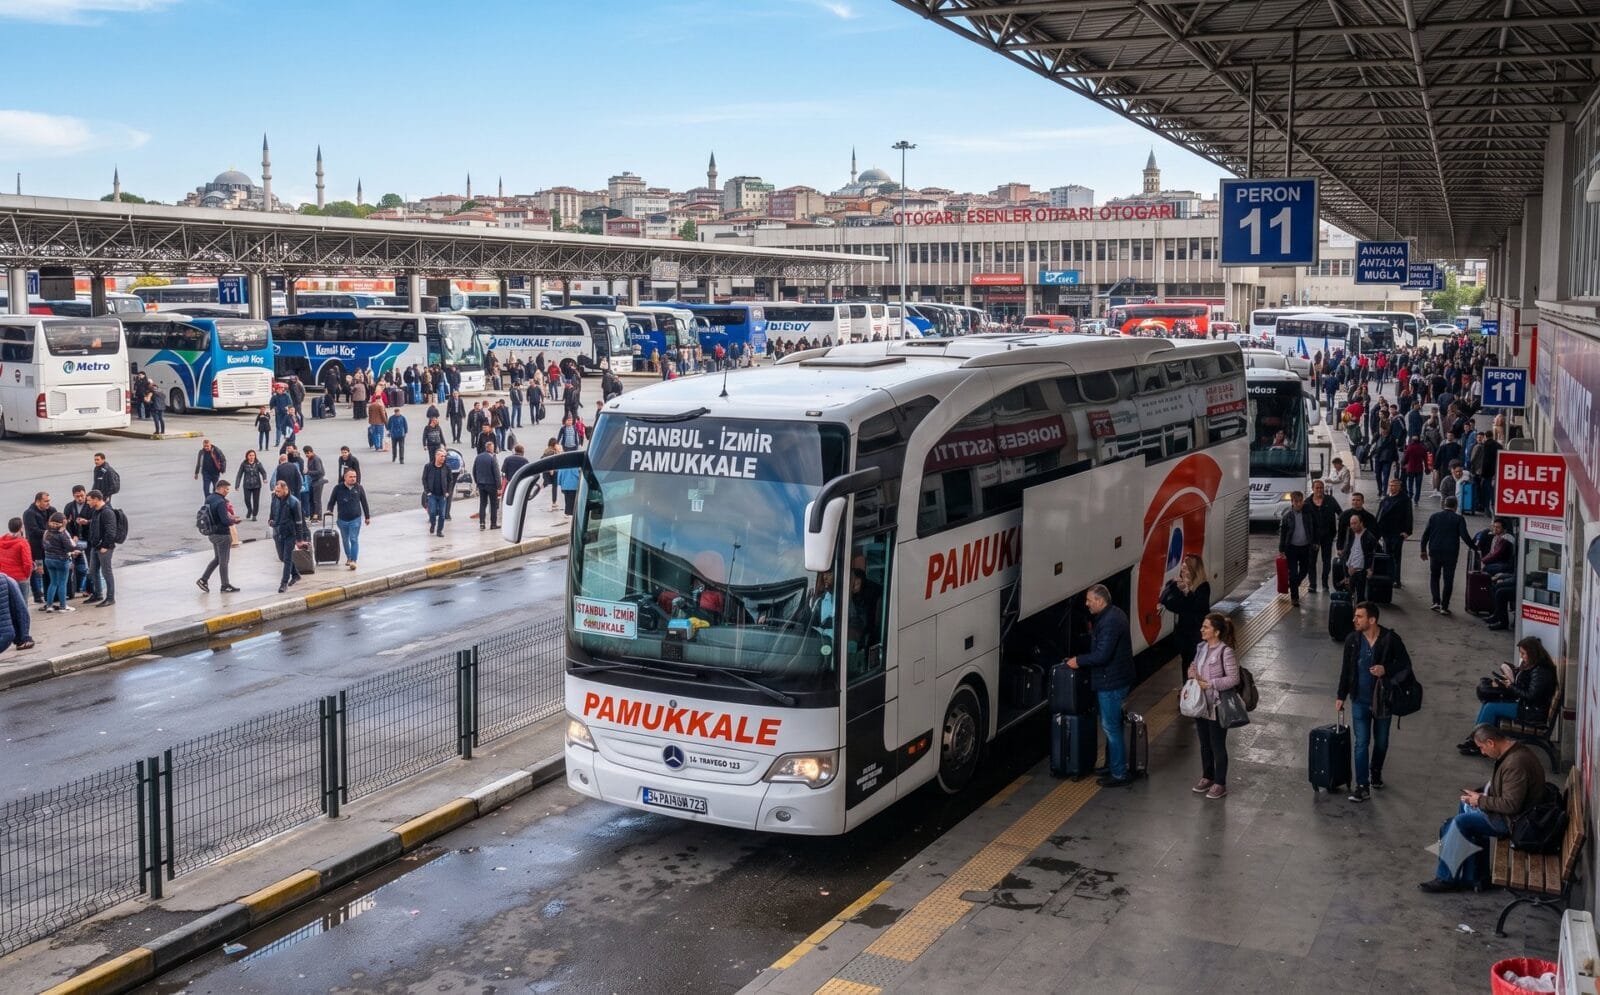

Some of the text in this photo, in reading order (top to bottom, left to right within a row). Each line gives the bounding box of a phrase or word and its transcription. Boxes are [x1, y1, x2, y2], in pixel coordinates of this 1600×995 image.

[1236, 186, 1301, 203] PERON
[967, 208, 1032, 223] ESENLER
[1239, 206, 1292, 255] 11
[1361, 246, 1404, 256] ANKARA
[1359, 258, 1405, 268] ANTALYA
[1364, 268, 1400, 280] MUĞLA
[222, 287, 238, 303] 11
[76, 362, 110, 372] Metro
[1487, 371, 1522, 380] PERON
[1491, 382, 1516, 402] 11
[621, 421, 703, 449] İSTANBUL
[719, 425, 772, 453] İZMİR
[629, 450, 758, 479] PAMUKKALE
[1503, 460, 1562, 482] BİLET
[1502, 487, 1560, 511] SATIŞ
[613, 605, 635, 622] İZMİR
[583, 691, 782, 747] PAMUKKALE
[699, 757, 728, 767] TRAVEGO
[689, 798, 705, 811] 723
